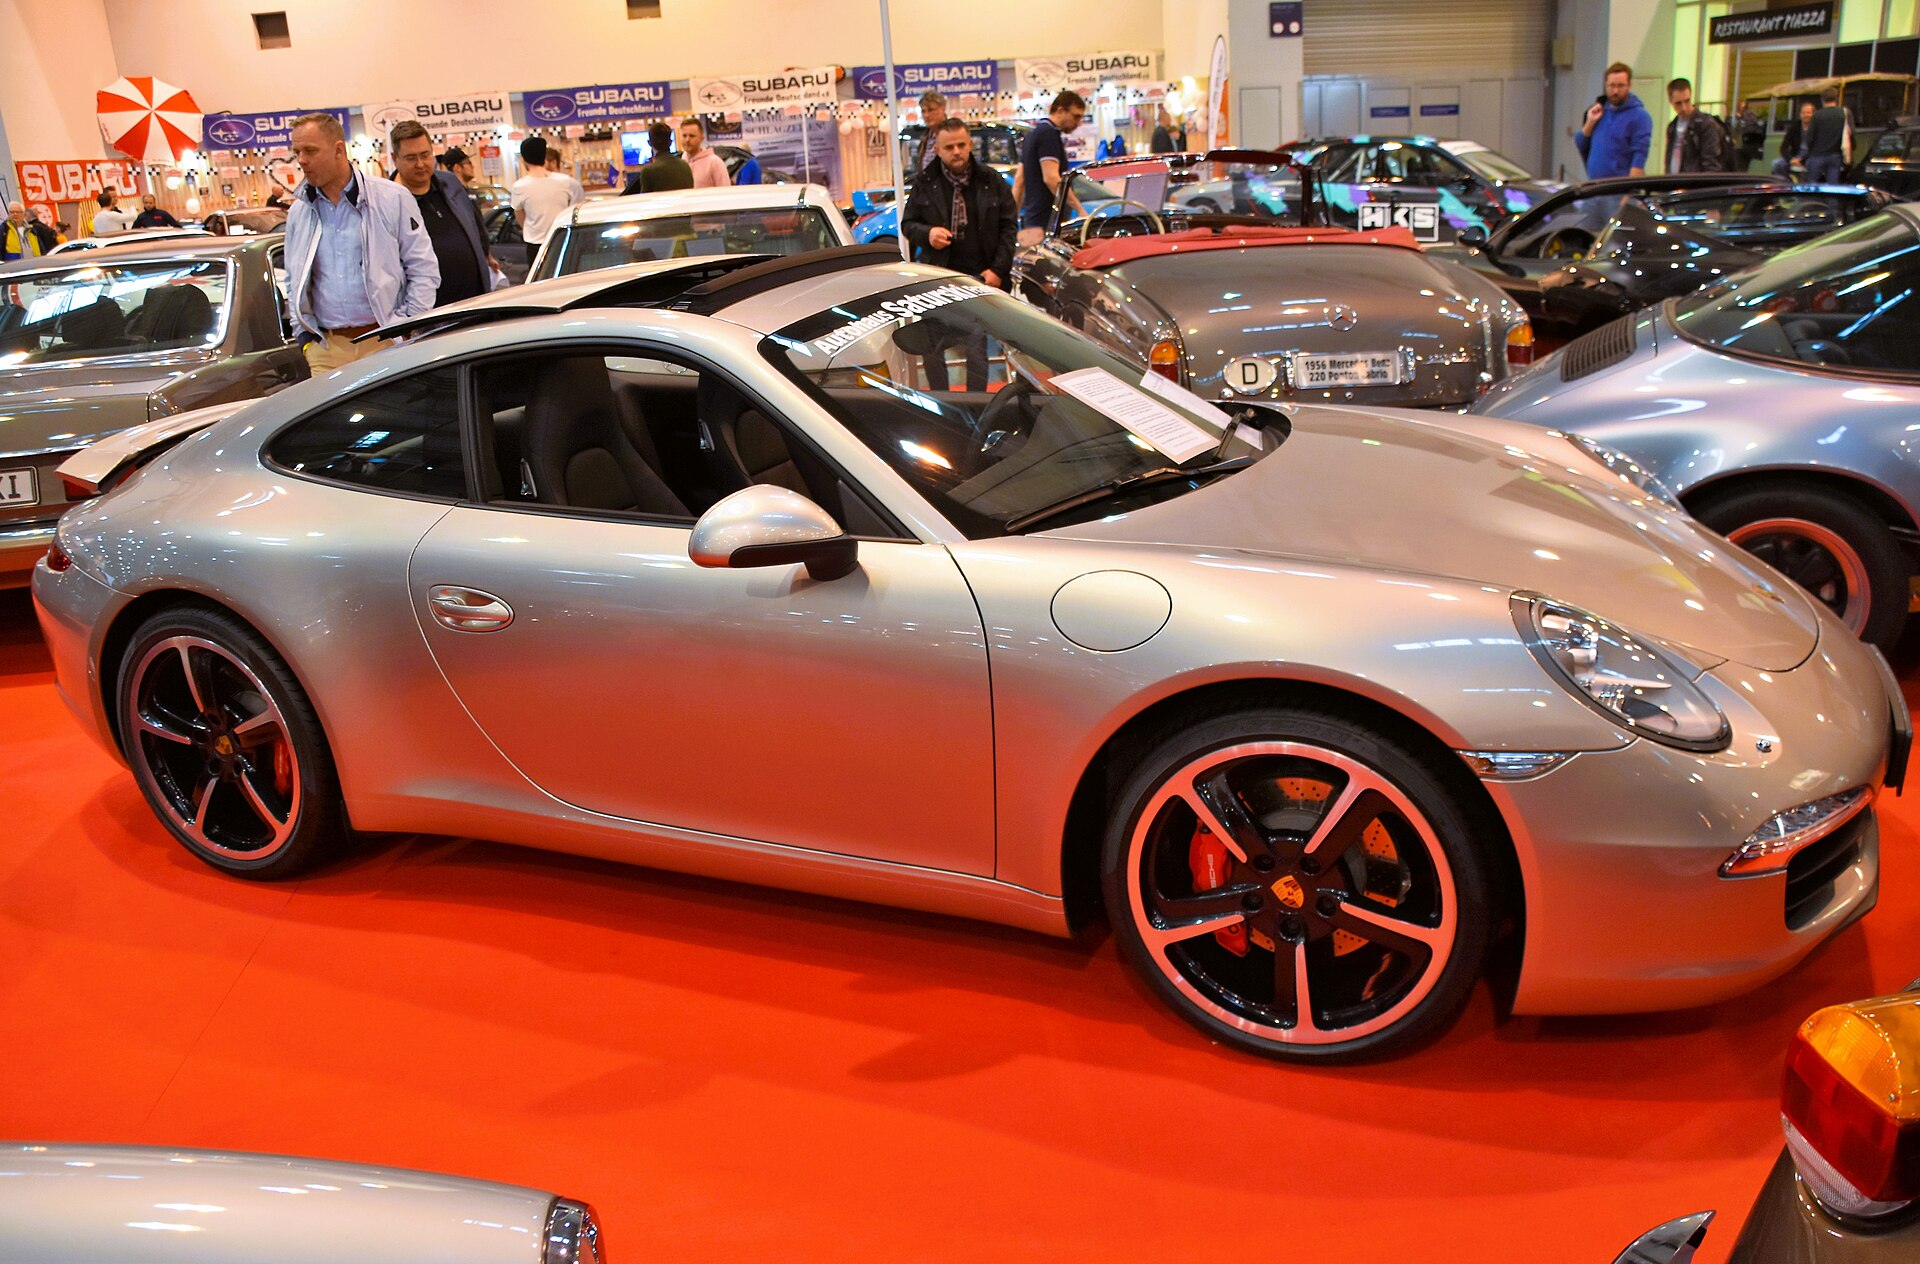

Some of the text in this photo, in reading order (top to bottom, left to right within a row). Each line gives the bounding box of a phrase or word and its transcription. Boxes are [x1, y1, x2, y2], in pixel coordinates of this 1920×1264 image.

[1714, 10, 1826, 37] RESTAURANT PIAZZA
[1066, 56, 1149, 73] SUBARU
[742, 73, 829, 92] SUBARU
[904, 65, 992, 83] SUBARU
[575, 87, 664, 105] SUBARU
[416, 99, 503, 117] SUBARU
[577, 106, 607, 118] Freunde
[608, 104, 655, 115] Deutschland
[450, 116, 494, 127] Deutschland
[22, 162, 137, 201] SUBARU
[1361, 205, 1436, 229] HKS
[814, 310, 895, 355] Autohaus
[1242, 363, 1258, 384] D
[1305, 361, 1327, 371] 1956
[1309, 372, 1326, 382] 220
